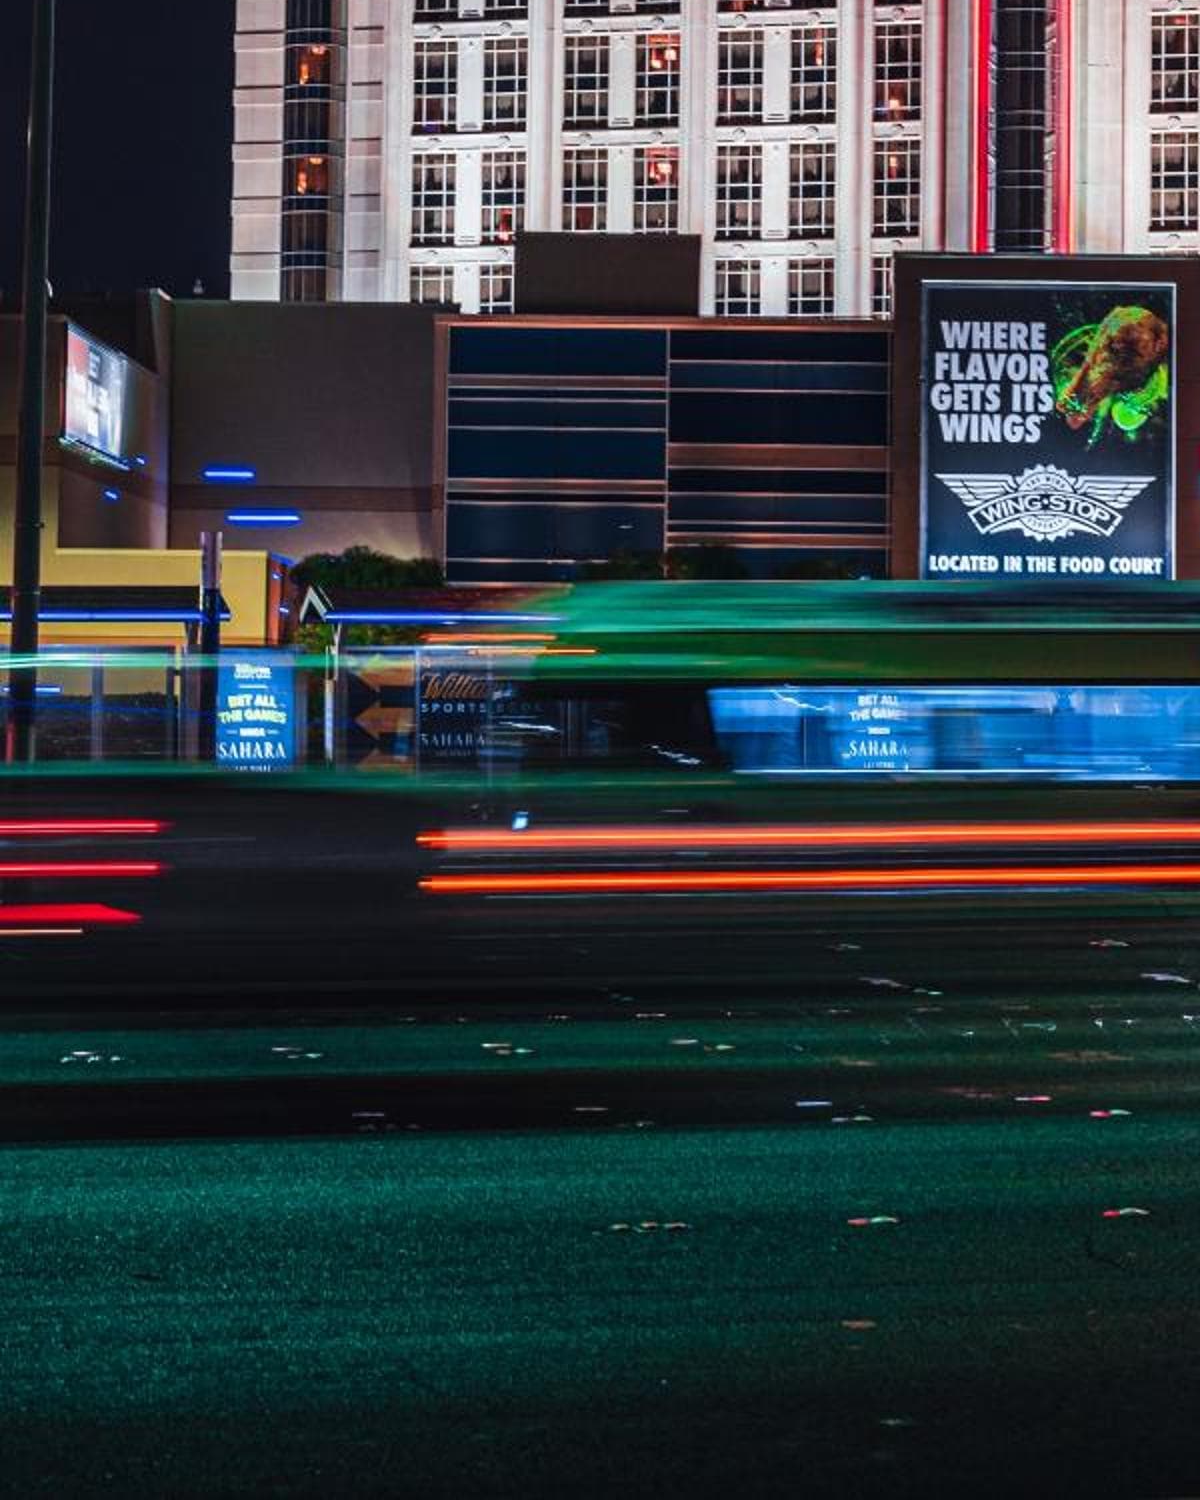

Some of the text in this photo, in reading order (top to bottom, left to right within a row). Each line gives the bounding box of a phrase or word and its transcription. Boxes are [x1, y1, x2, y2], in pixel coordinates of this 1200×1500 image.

[940, 320, 1047, 350] WHERE
[934, 351, 1050, 382] FLAVOR
[930, 382, 1055, 413] GETS ITS
[939, 413, 1042, 443] WINGS
[929, 555, 1164, 575] LOCATED IN THE FOOD COURT
[227, 693, 277, 709] BET ALL
[421, 703, 487, 713] SPORTS
[217, 709, 243, 724] THE
[218, 741, 287, 759] SAHARA
